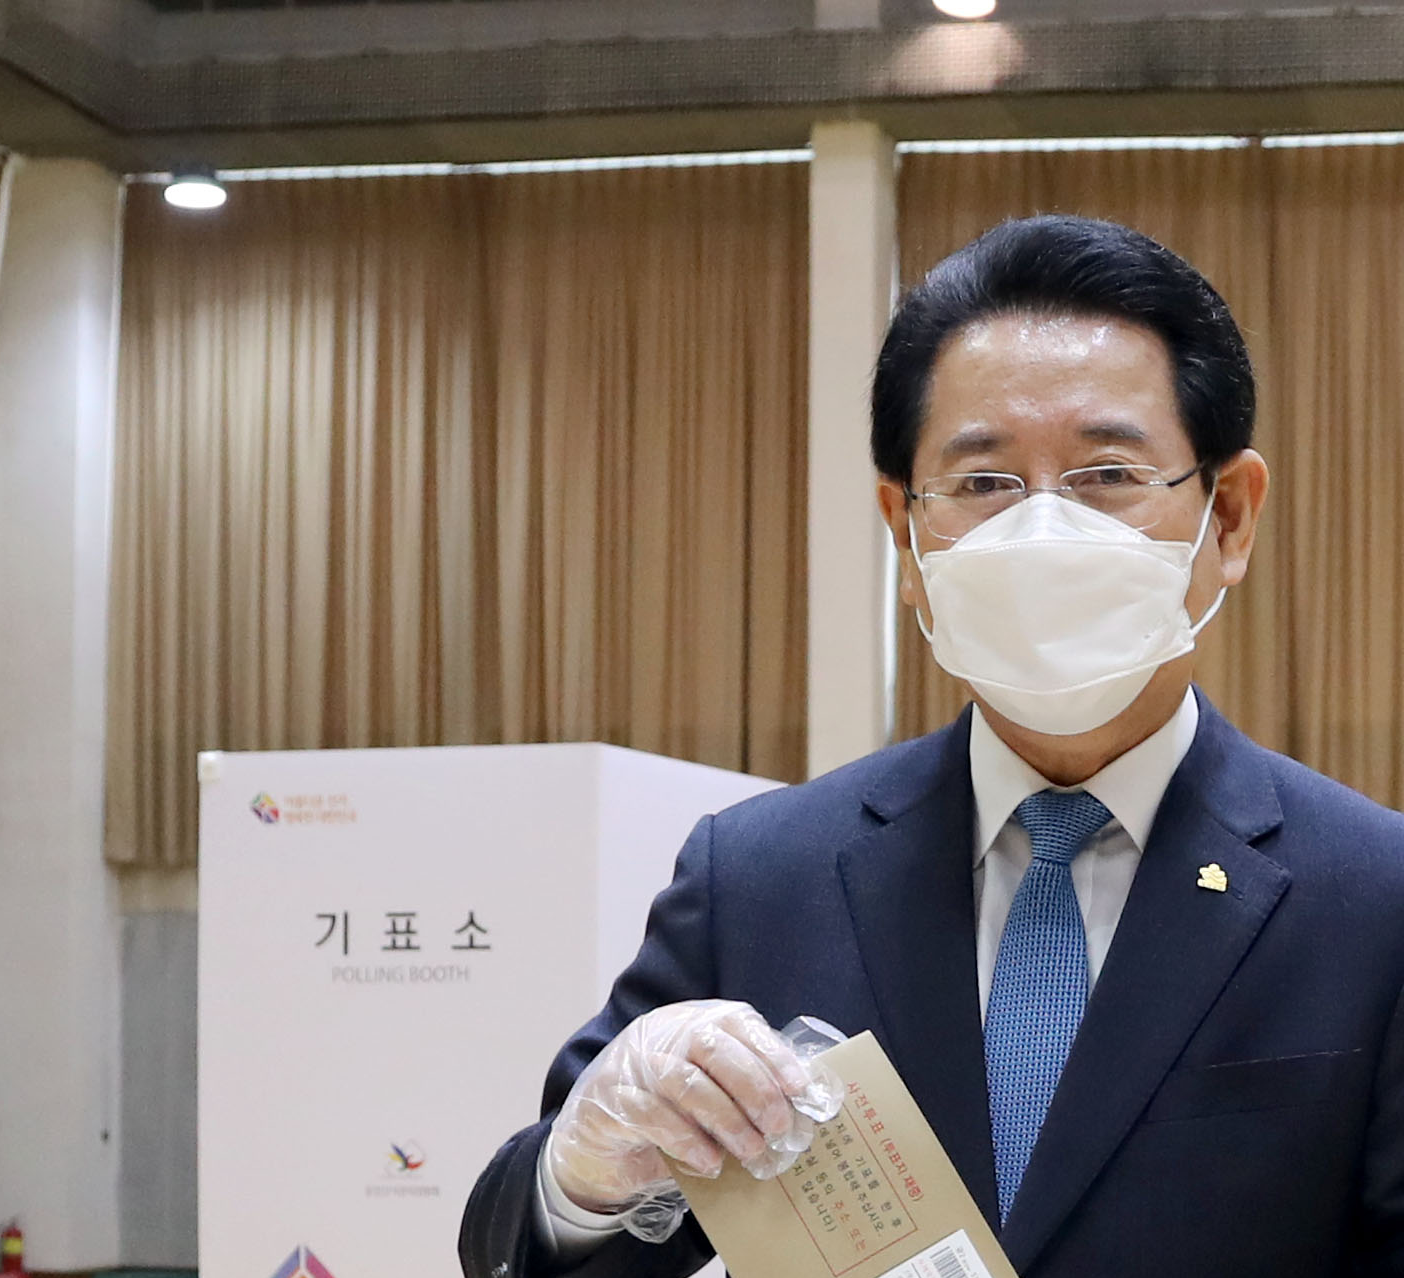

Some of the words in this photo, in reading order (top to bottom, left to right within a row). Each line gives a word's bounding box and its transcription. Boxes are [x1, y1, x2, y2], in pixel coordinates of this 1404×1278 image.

[331, 965, 404, 983] POLLING
[409, 964, 470, 983] BOOTH
[845, 1079, 885, 1135] 사전투표
[879, 1136, 909, 1175] (투표지
